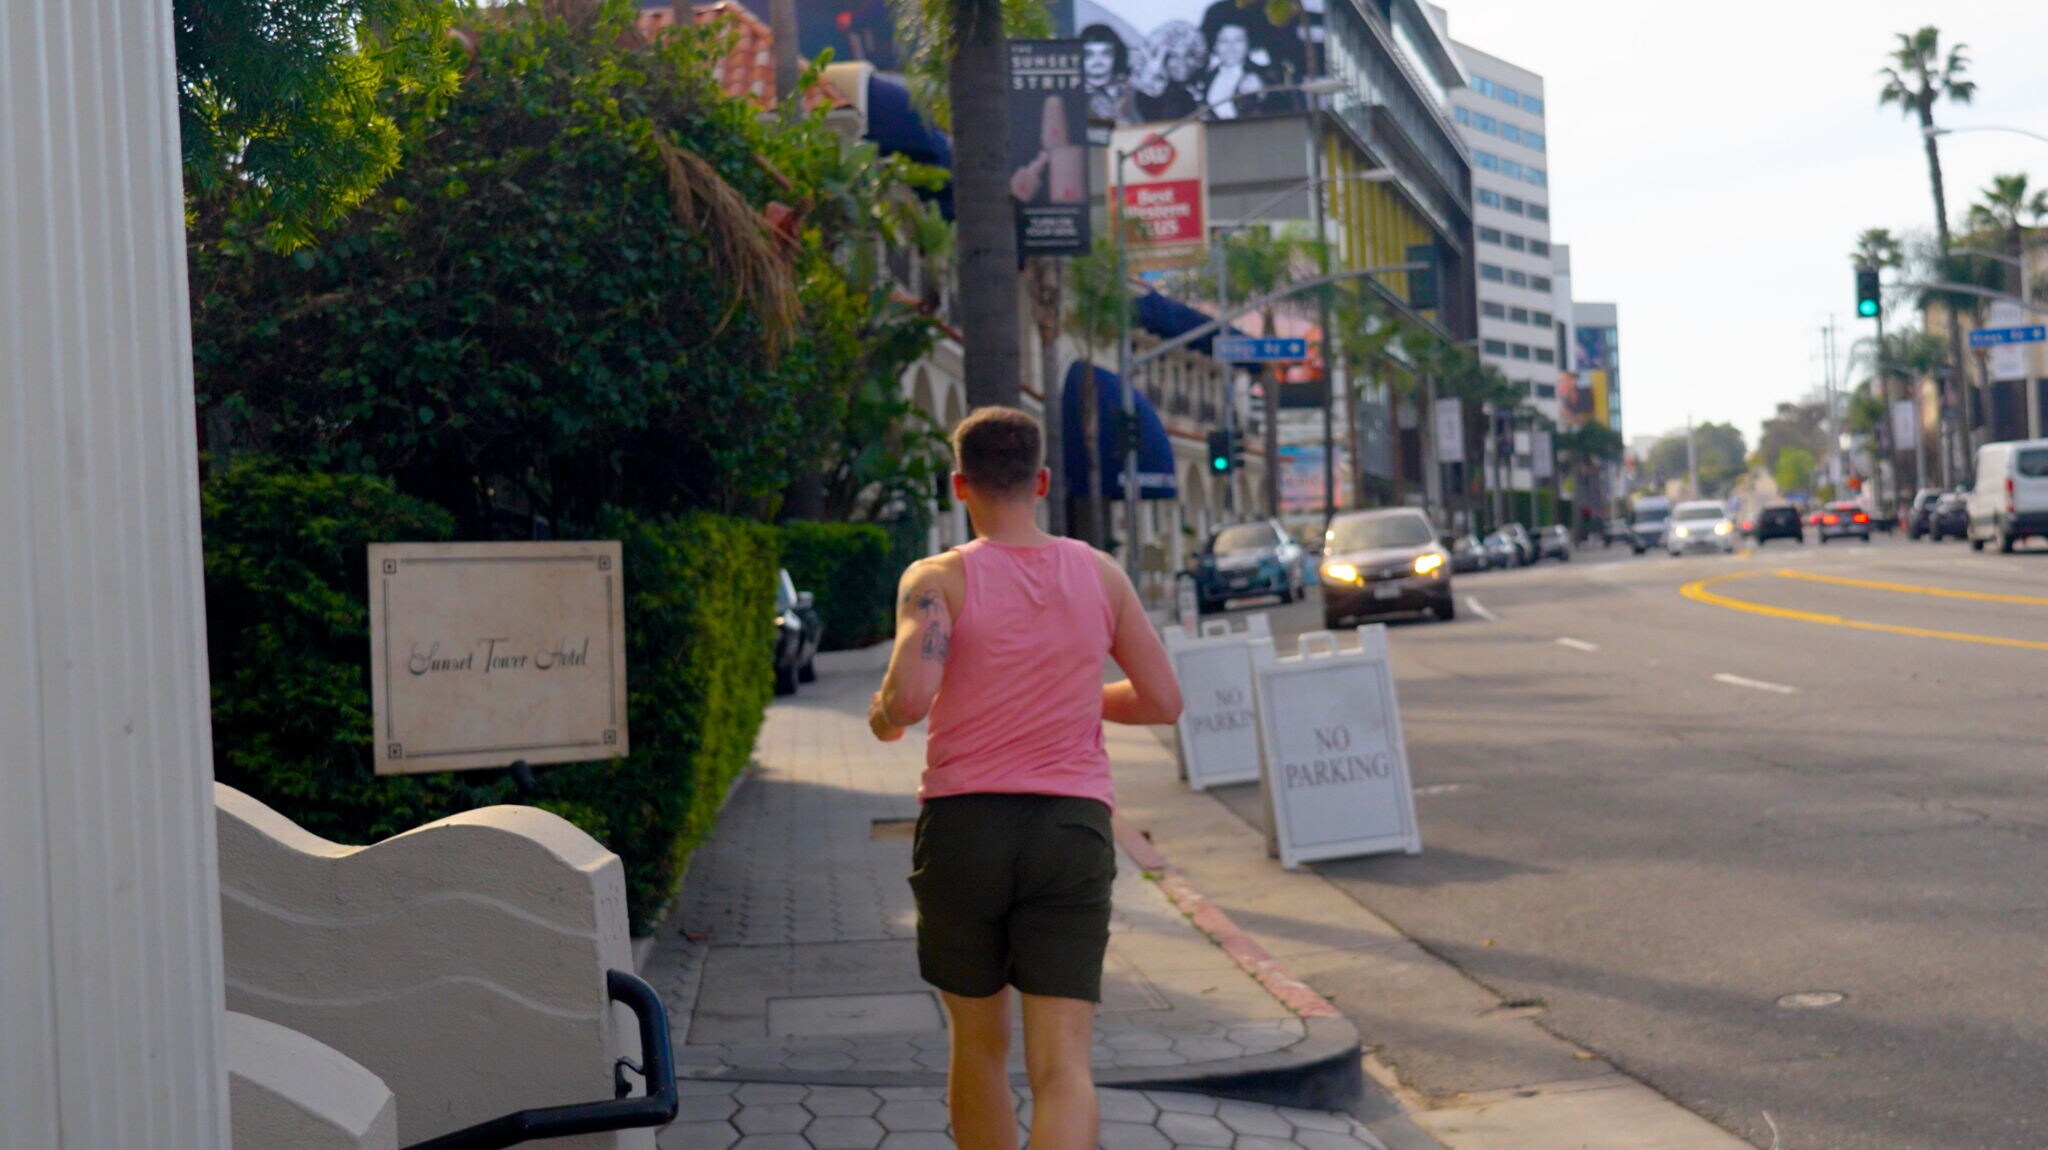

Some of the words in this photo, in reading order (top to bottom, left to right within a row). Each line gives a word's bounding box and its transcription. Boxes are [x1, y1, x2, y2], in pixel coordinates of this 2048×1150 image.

[1010, 53, 1080, 69] SUNSET
[1011, 76, 1081, 91] STRIP
[1136, 188, 1174, 206] Best
[408, 640, 474, 676] Sunset
[477, 637, 529, 674] Tower
[535, 636, 590, 670] Hotel
[1214, 685, 1245, 707] NO
[1313, 725, 1350, 753] NO
[1285, 751, 1390, 790] PARKING
